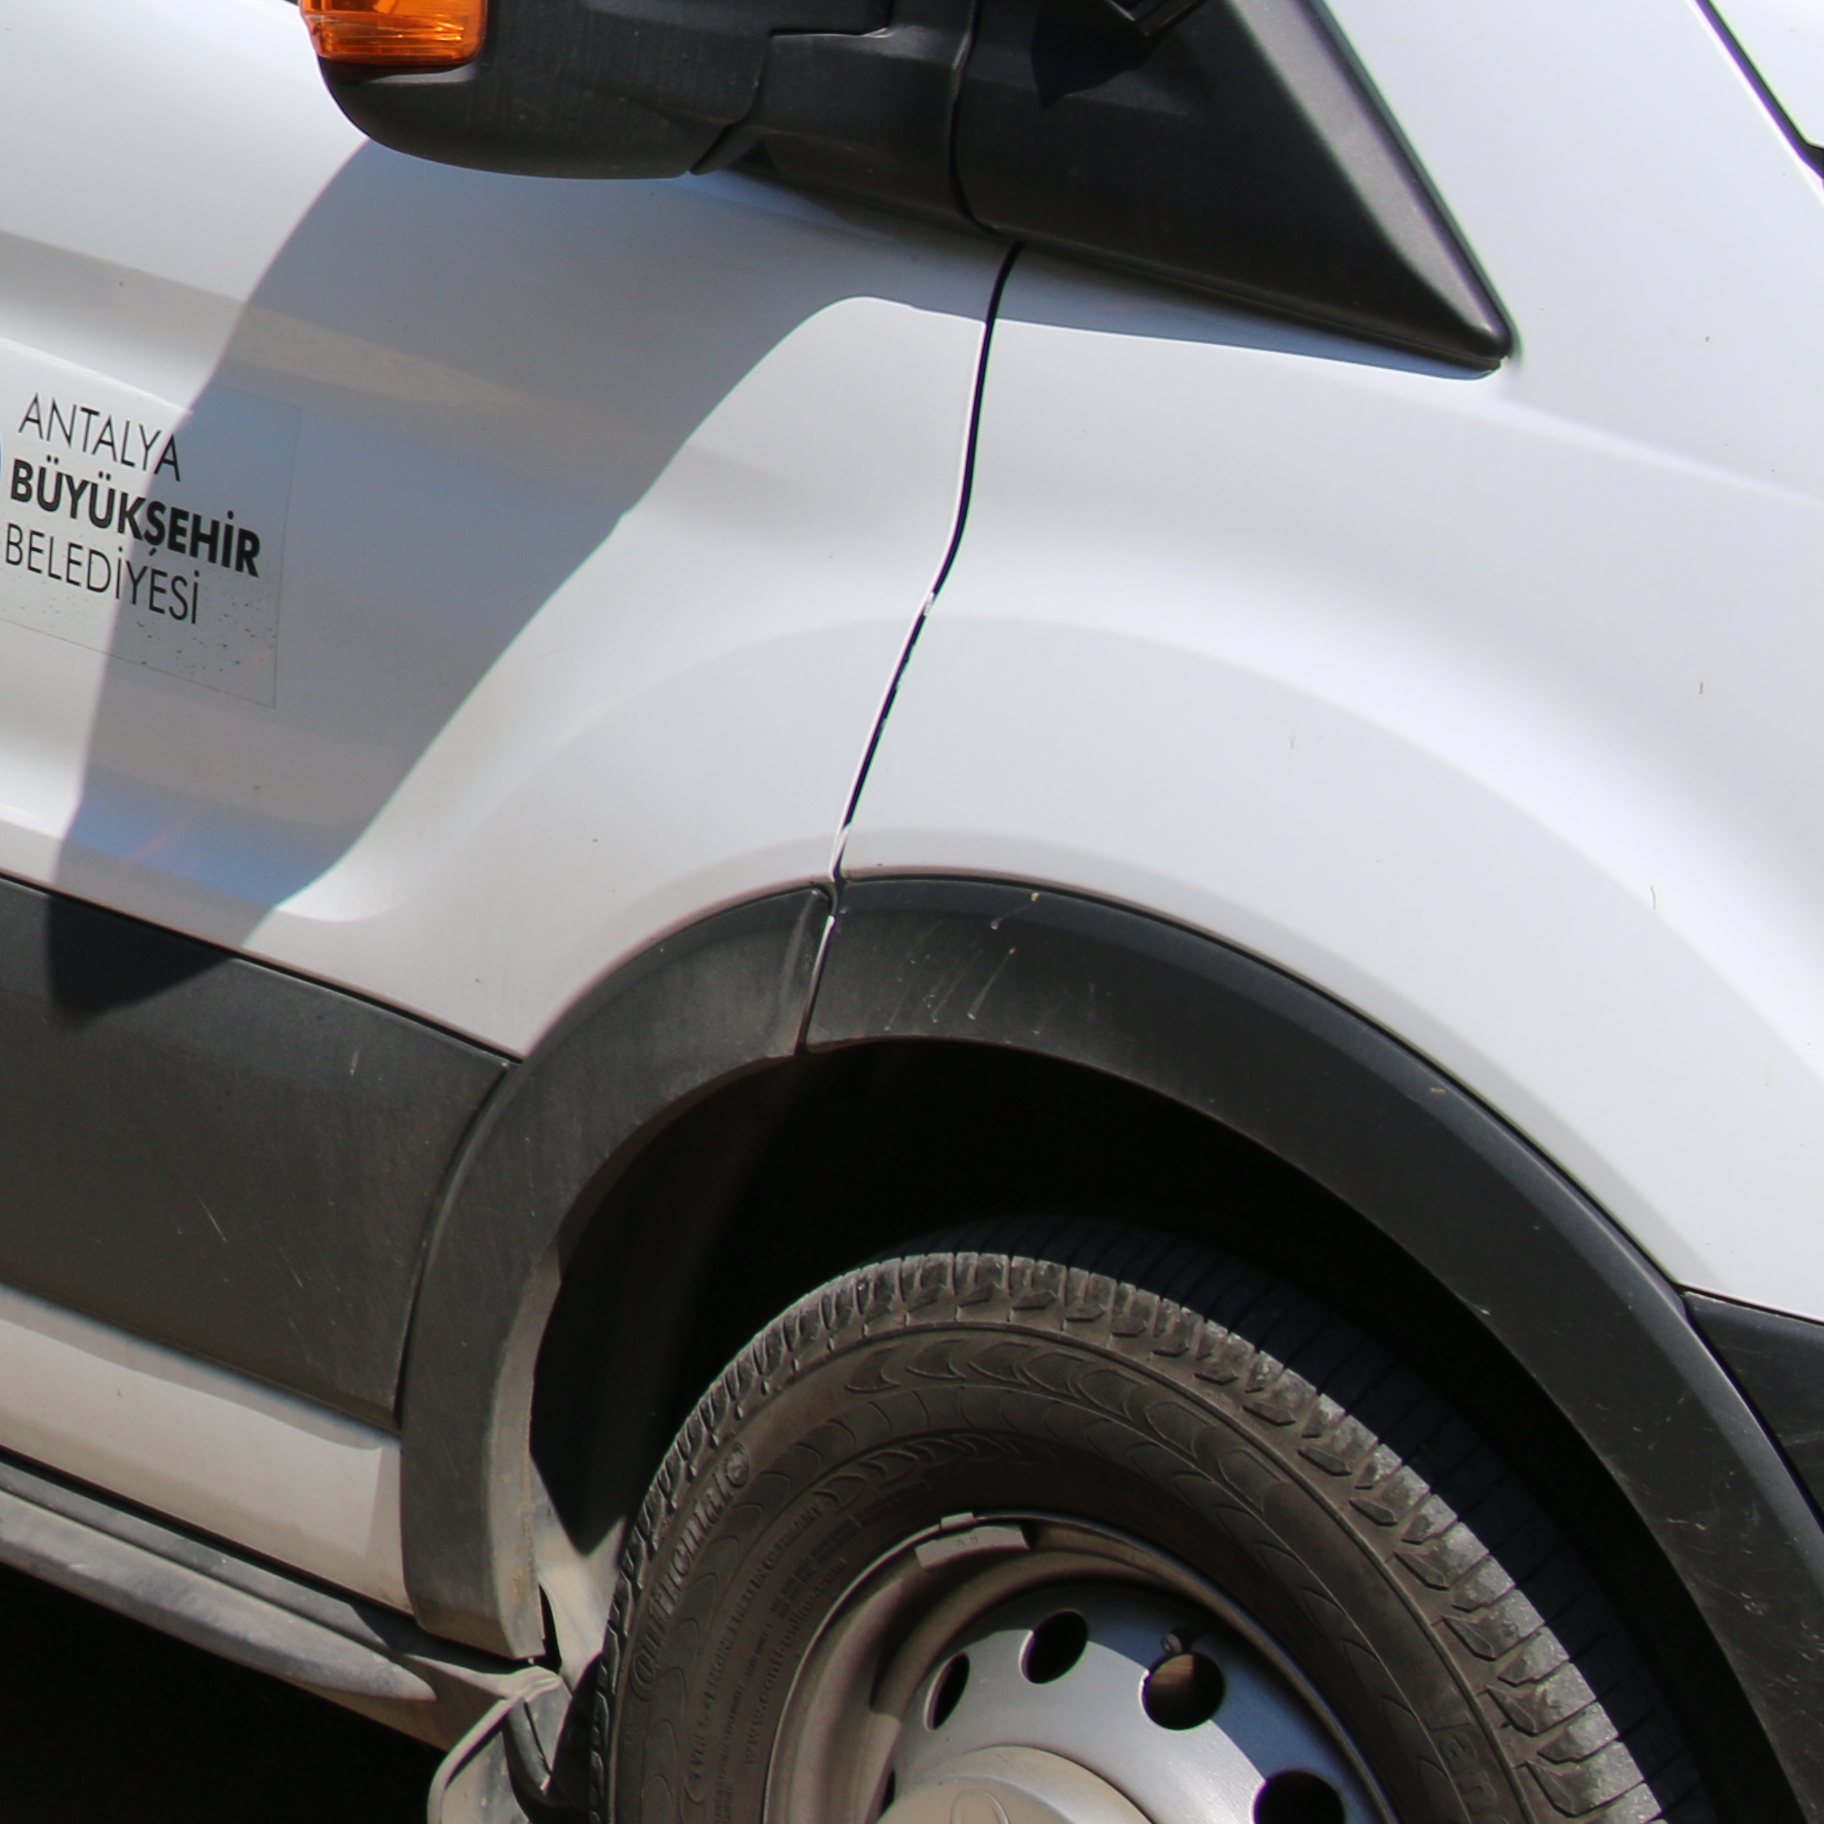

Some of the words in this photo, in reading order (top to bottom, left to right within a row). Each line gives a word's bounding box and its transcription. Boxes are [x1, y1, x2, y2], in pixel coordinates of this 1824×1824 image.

[17, 391, 182, 483] ANTALYA
[5, 522, 200, 625] BELEDİYESİ
[10, 454, 261, 578] BÜYÜKŞEHİR
[630, 1468, 736, 1702] Continental
[1423, 1686, 1510, 1824] Van
